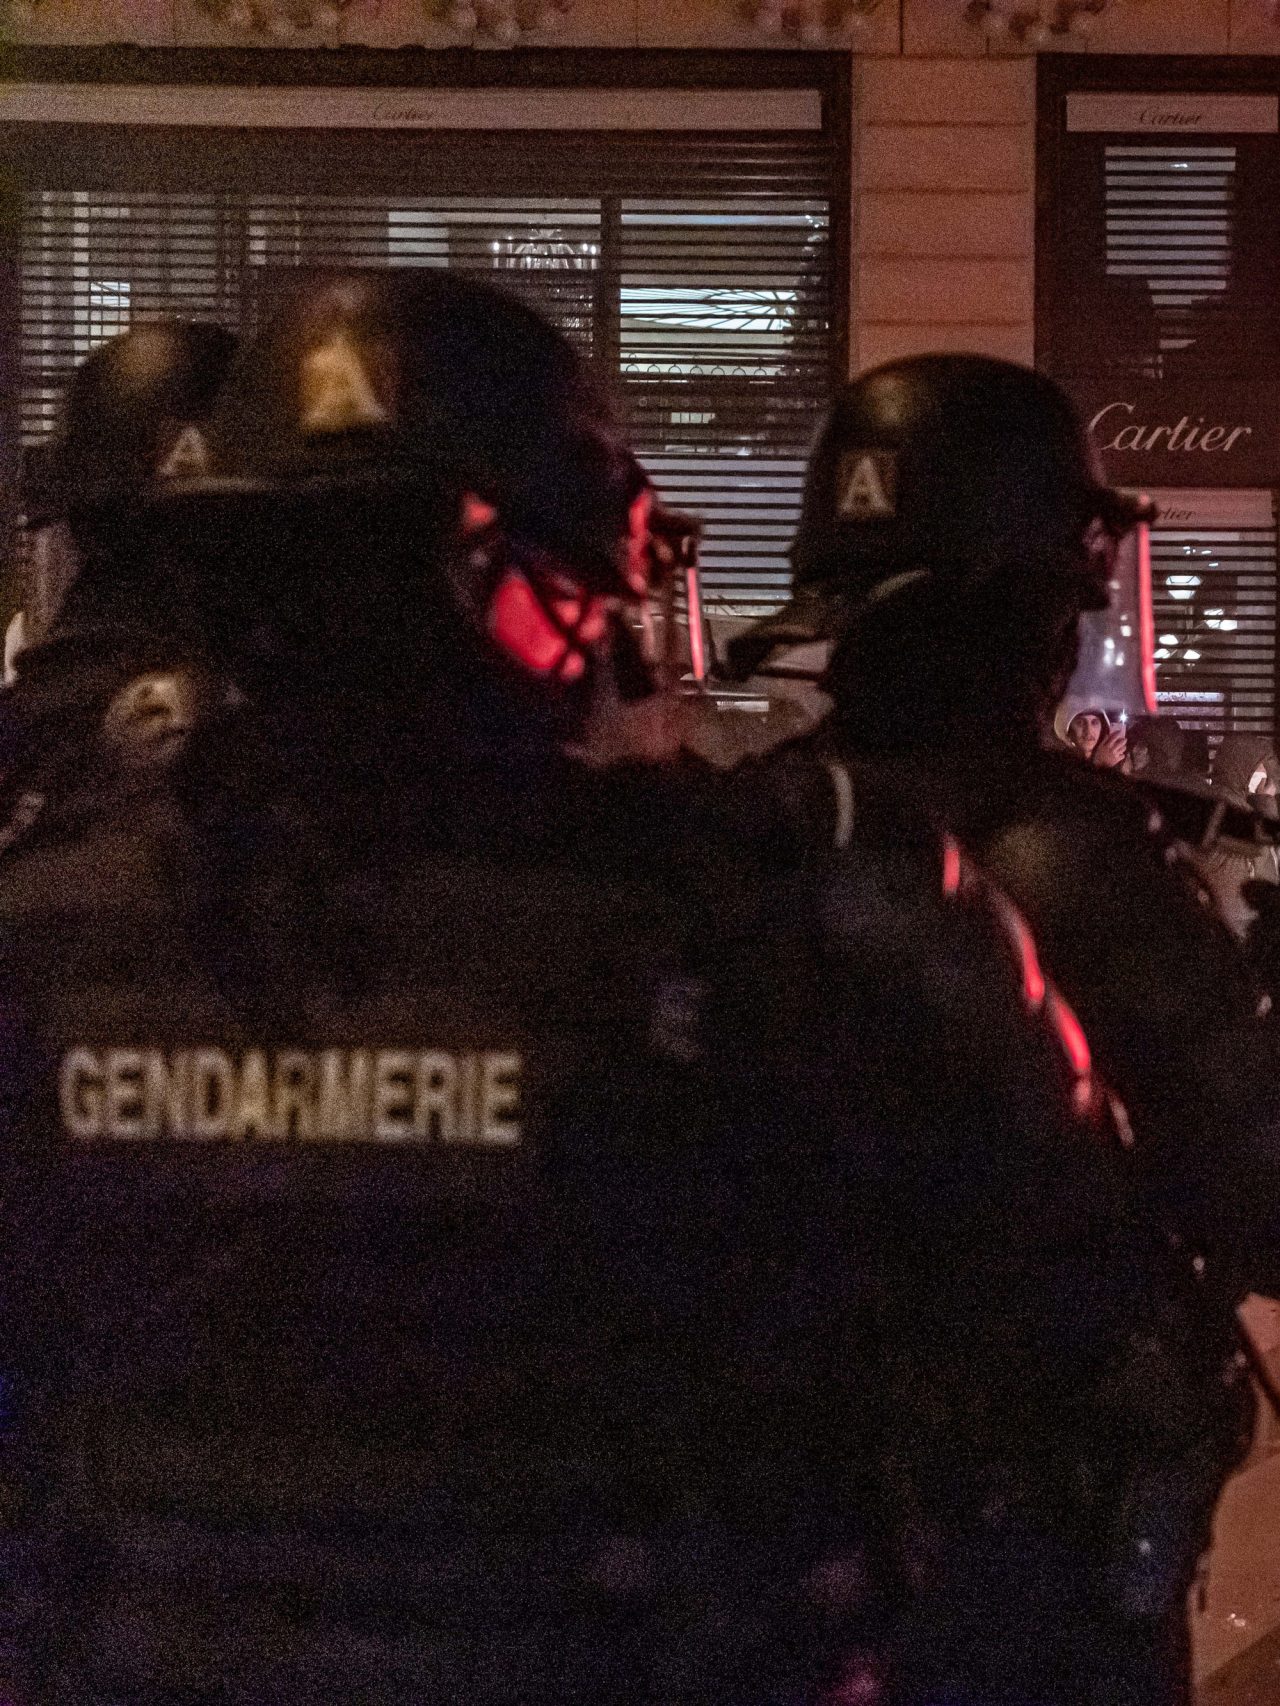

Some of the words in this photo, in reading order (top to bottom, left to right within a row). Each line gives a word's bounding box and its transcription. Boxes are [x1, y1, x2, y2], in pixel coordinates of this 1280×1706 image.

[1139, 105, 1201, 125] Cartier
[1088, 402, 1252, 451] Cartier
[840, 455, 890, 512] A
[1156, 507, 1195, 521] rtier
[60, 1048, 522, 1144] GENDARMERIE
